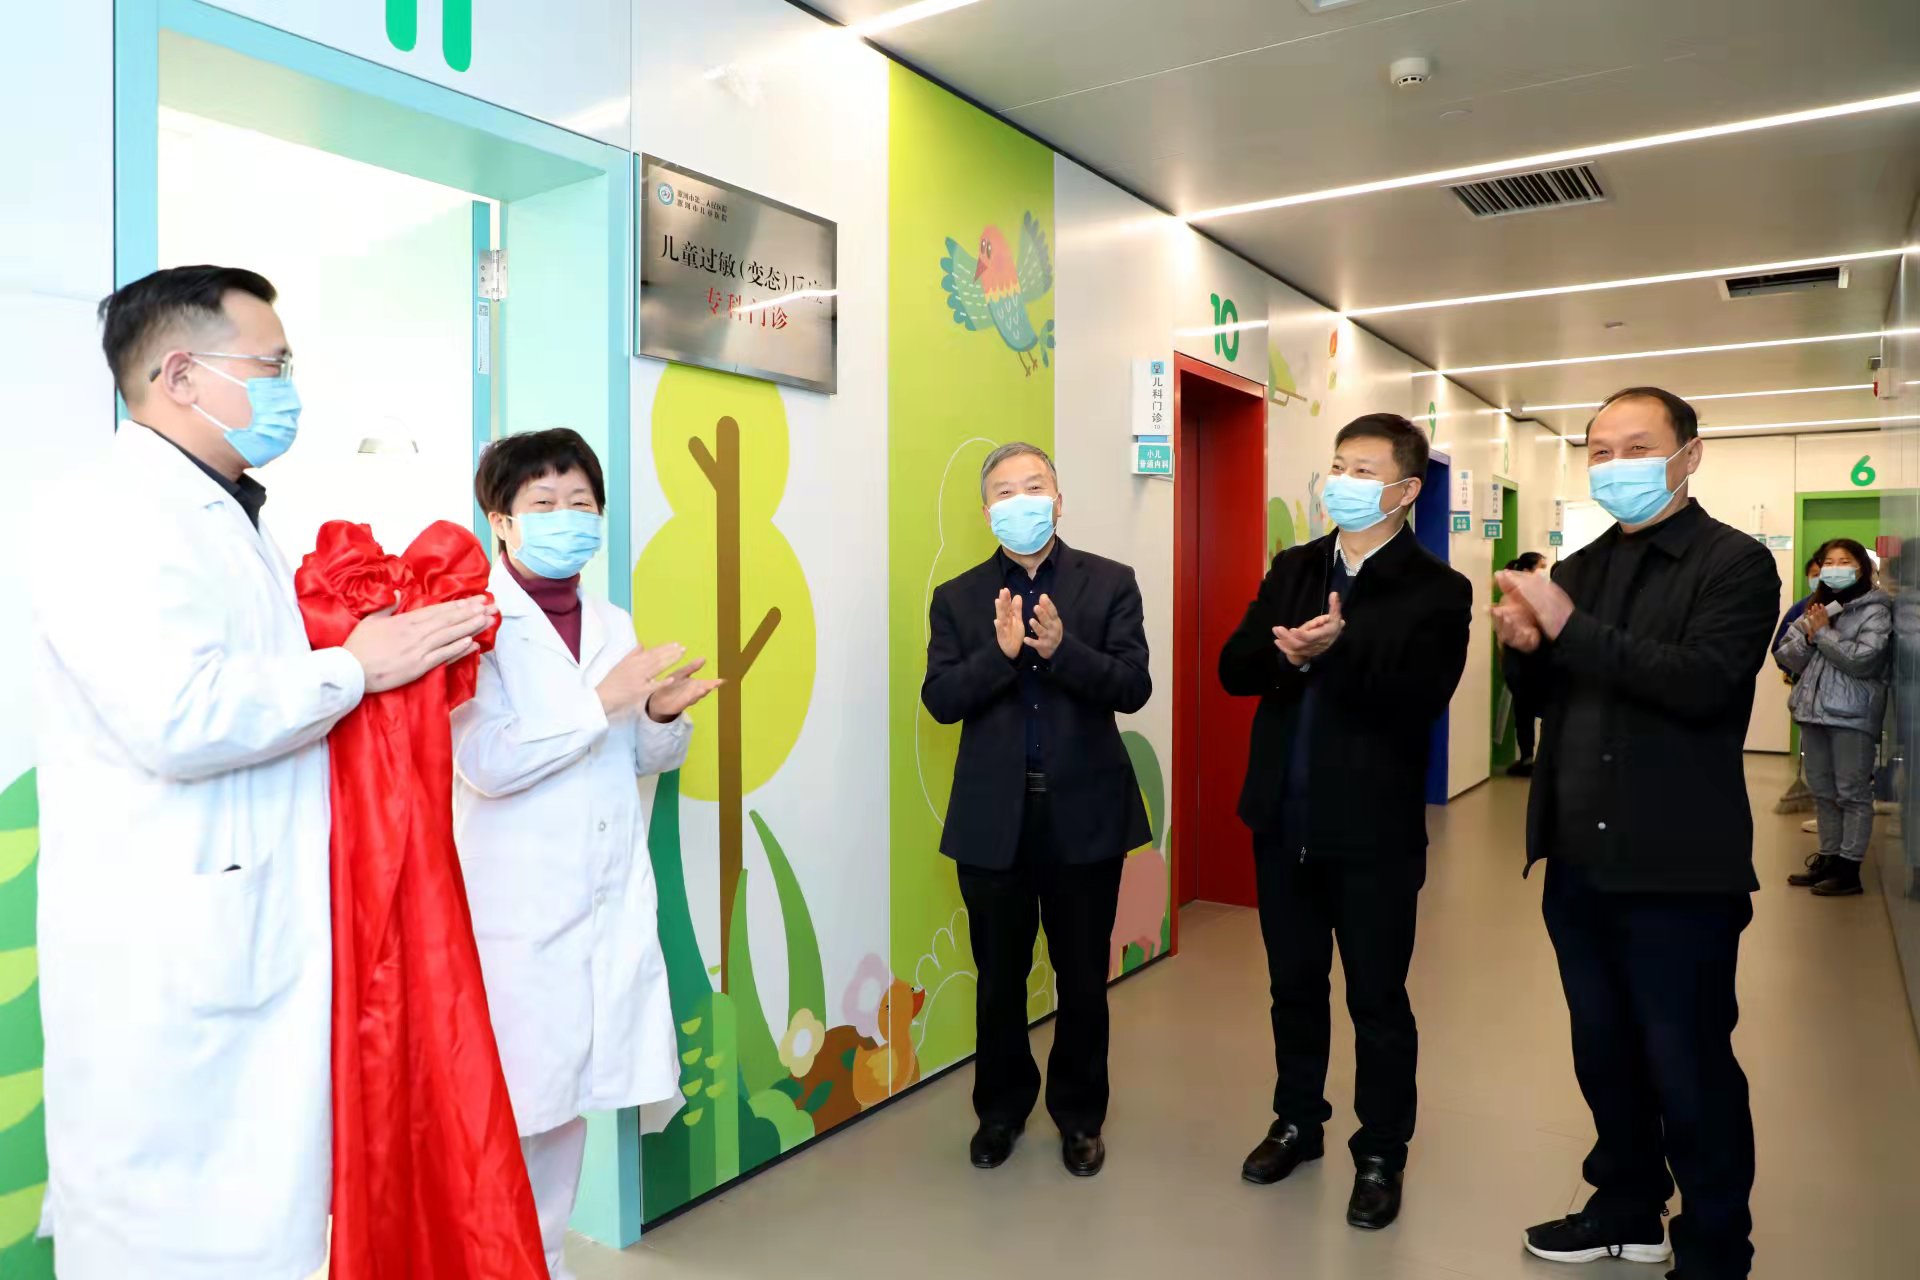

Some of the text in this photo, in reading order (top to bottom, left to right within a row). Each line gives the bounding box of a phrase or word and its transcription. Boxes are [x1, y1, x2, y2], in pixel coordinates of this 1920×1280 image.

[704, 287, 788, 329] 专科门诊
[1210, 292, 1239, 362] 10
[1152, 377, 1163, 423] 儿科门诊
[1147, 449, 1162, 459] 小儿
[1850, 454, 1876, 487] 6
